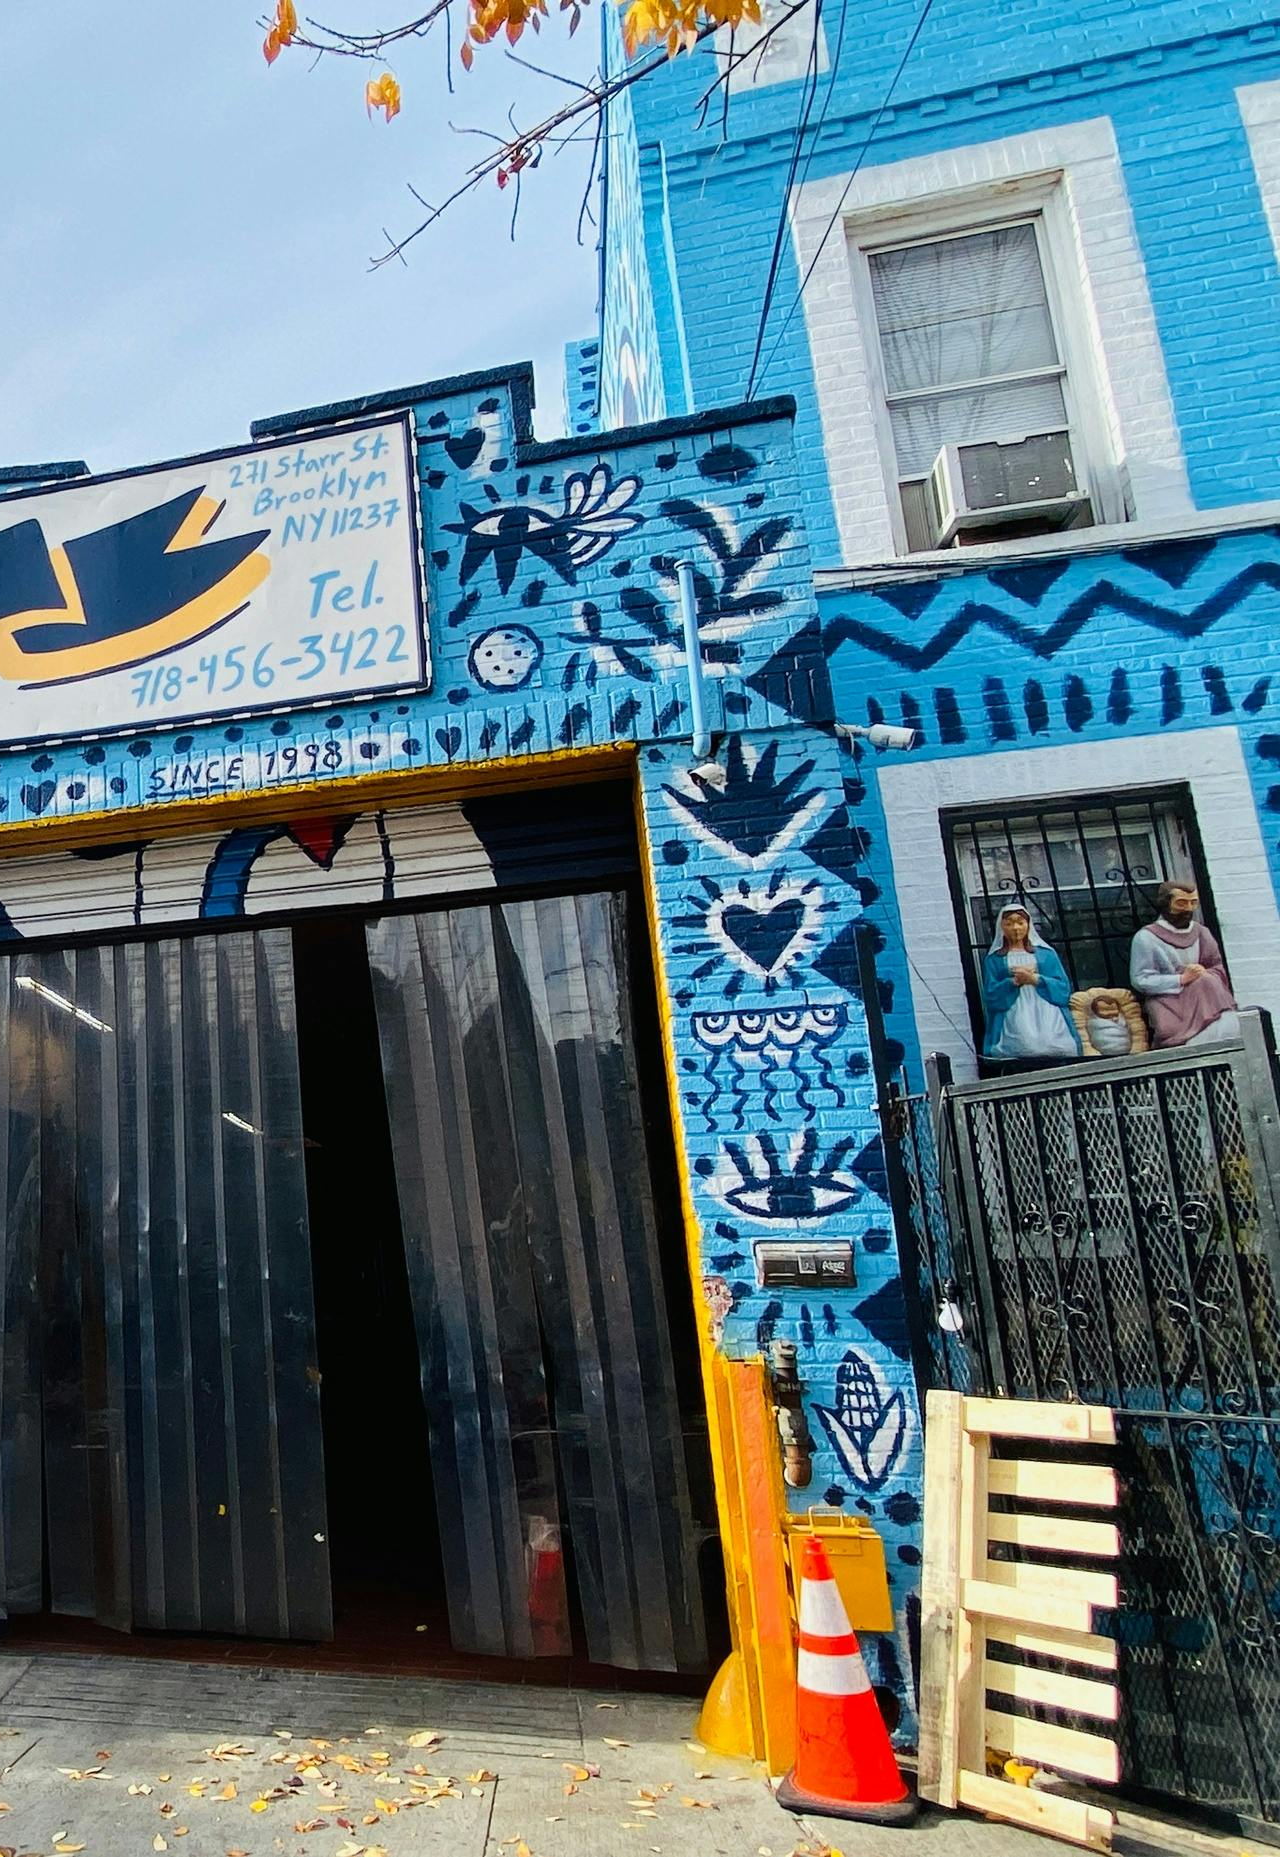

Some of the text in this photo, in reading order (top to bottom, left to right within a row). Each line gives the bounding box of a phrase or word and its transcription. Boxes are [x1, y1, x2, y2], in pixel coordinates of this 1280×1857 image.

[229, 433, 391, 489] 271 Starr St.
[253, 467, 387, 516] Brooklyn
[281, 498, 402, 548] NY 11237
[308, 559, 385, 619] Tel.
[131, 624, 410, 709] 718-456-3422
[148, 739, 344, 791] SINCE 1998
